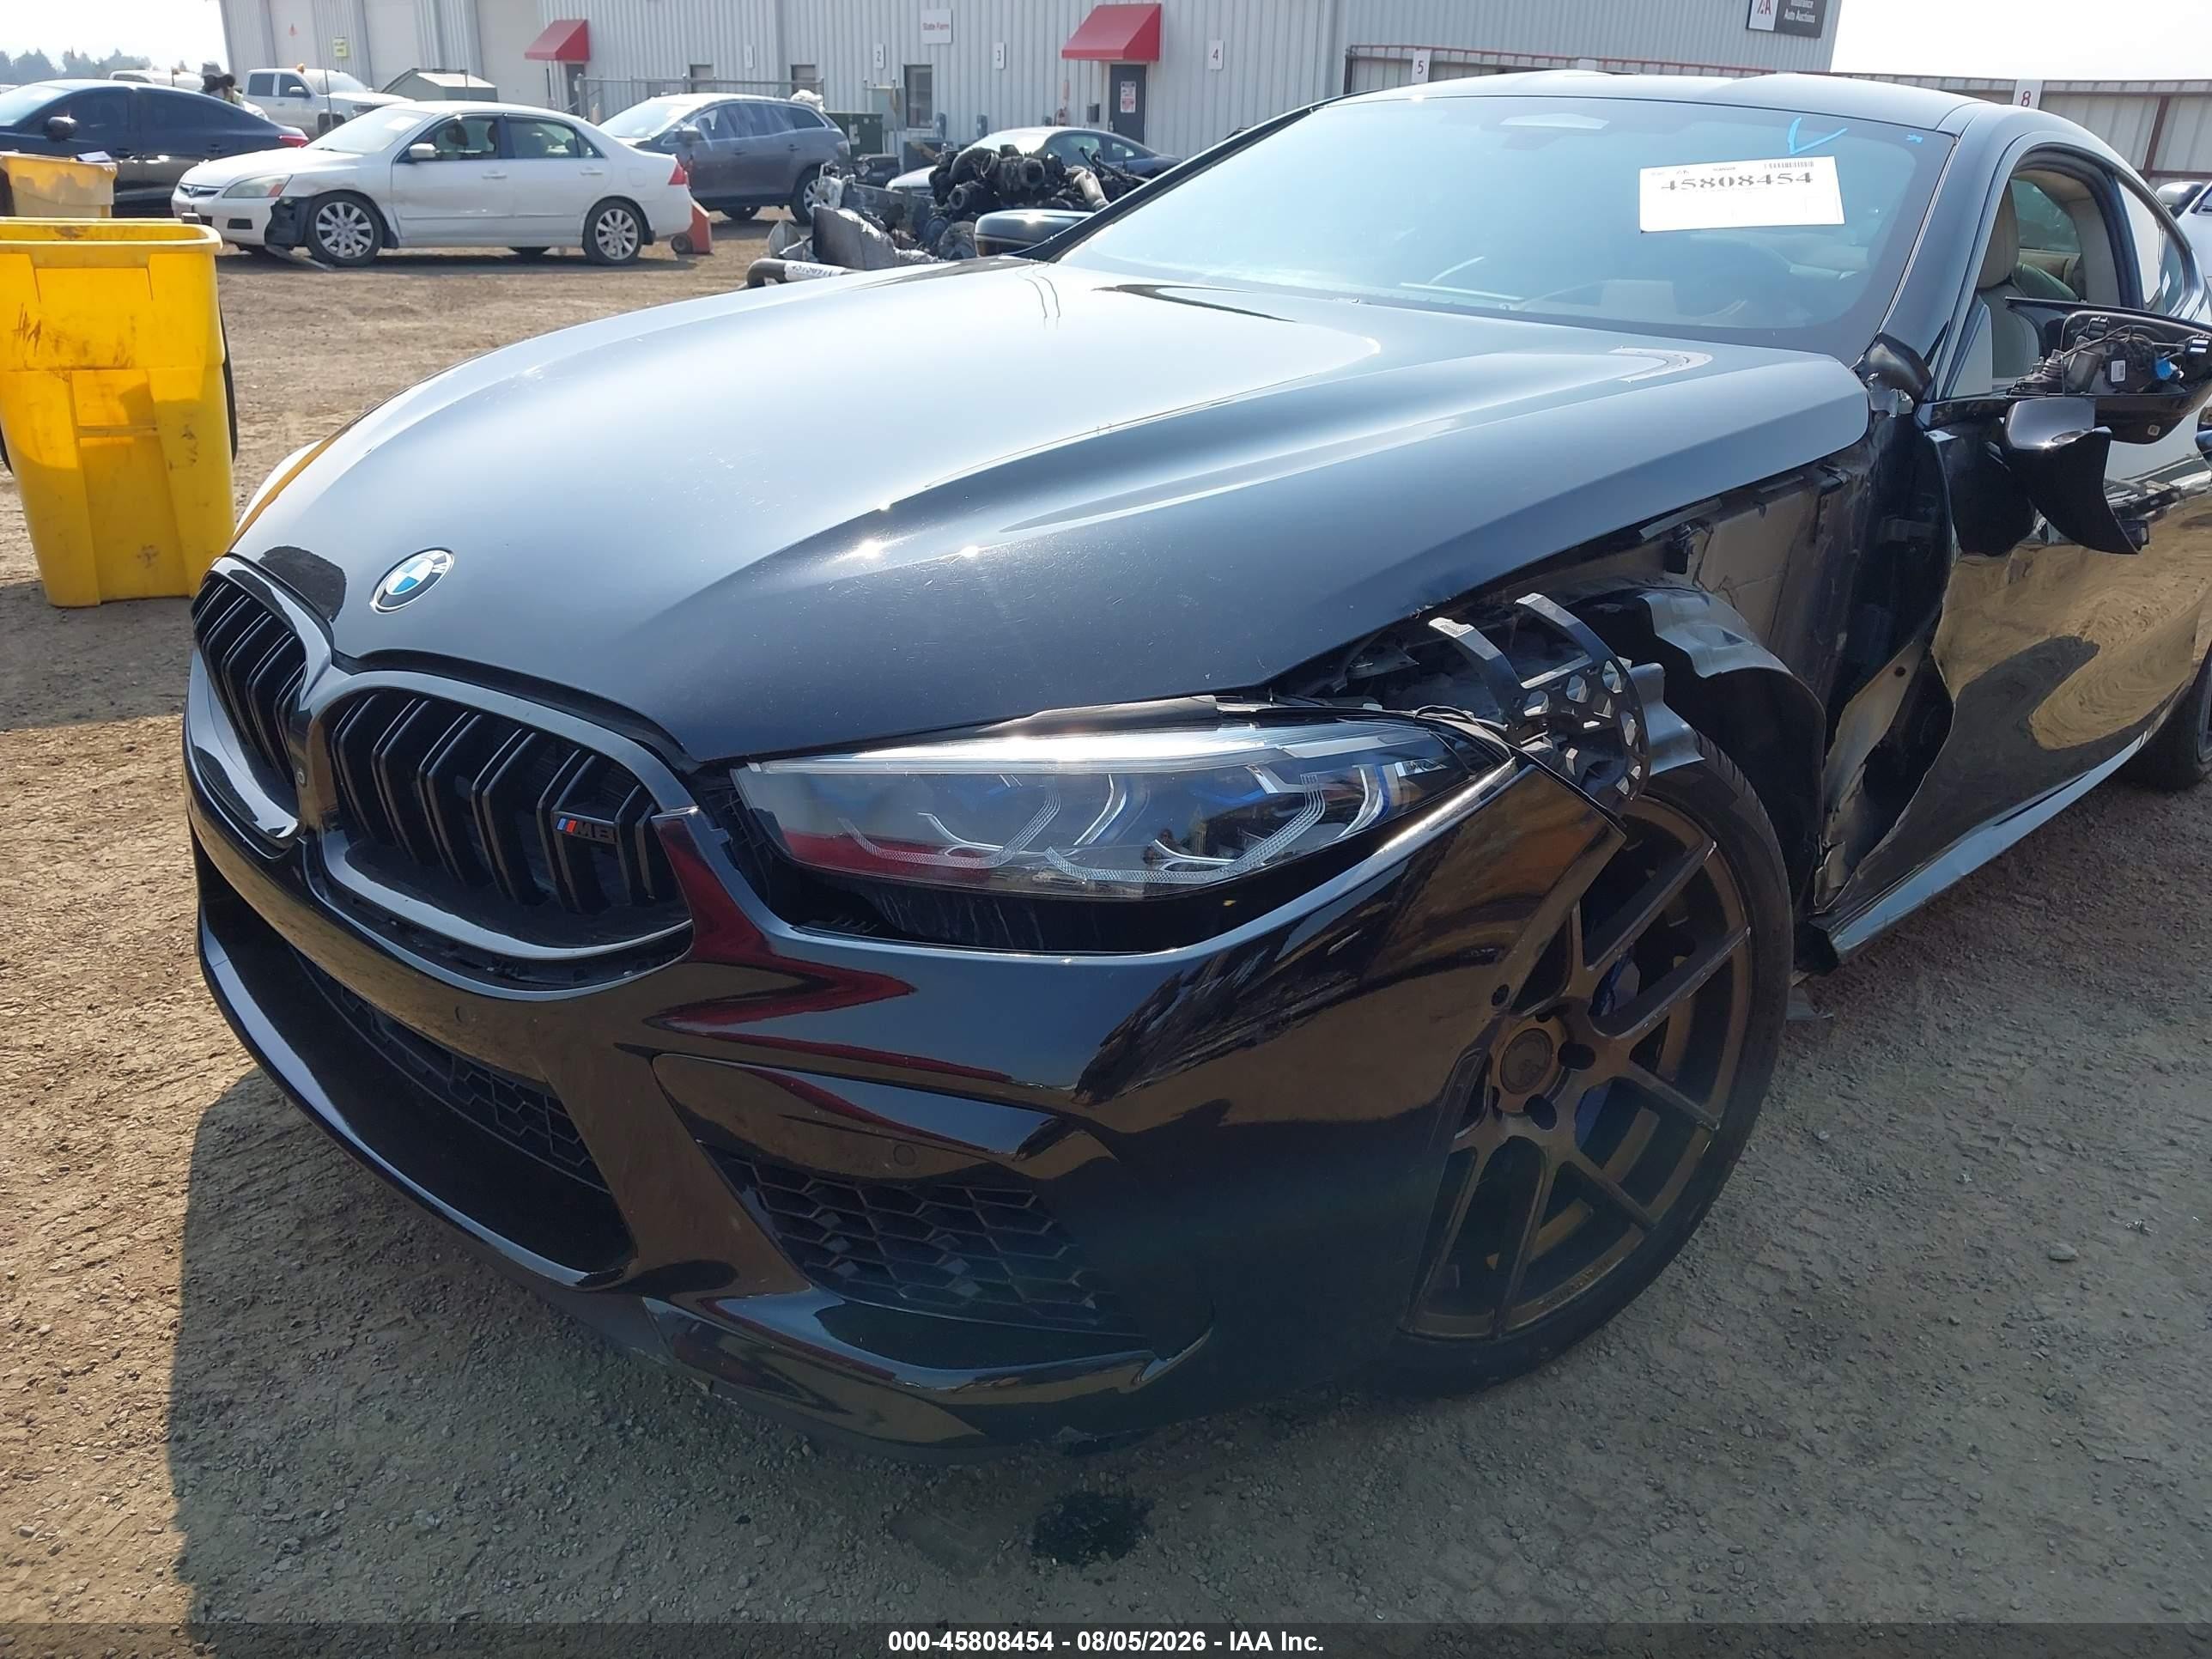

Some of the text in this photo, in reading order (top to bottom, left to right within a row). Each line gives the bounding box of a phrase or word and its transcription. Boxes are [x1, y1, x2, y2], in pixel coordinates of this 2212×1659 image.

[1212, 48, 1219, 62] 4
[1417, 60, 1425, 75] 5
[2021, 90, 2032, 107] 8
[1661, 172, 1814, 191] 45808454
